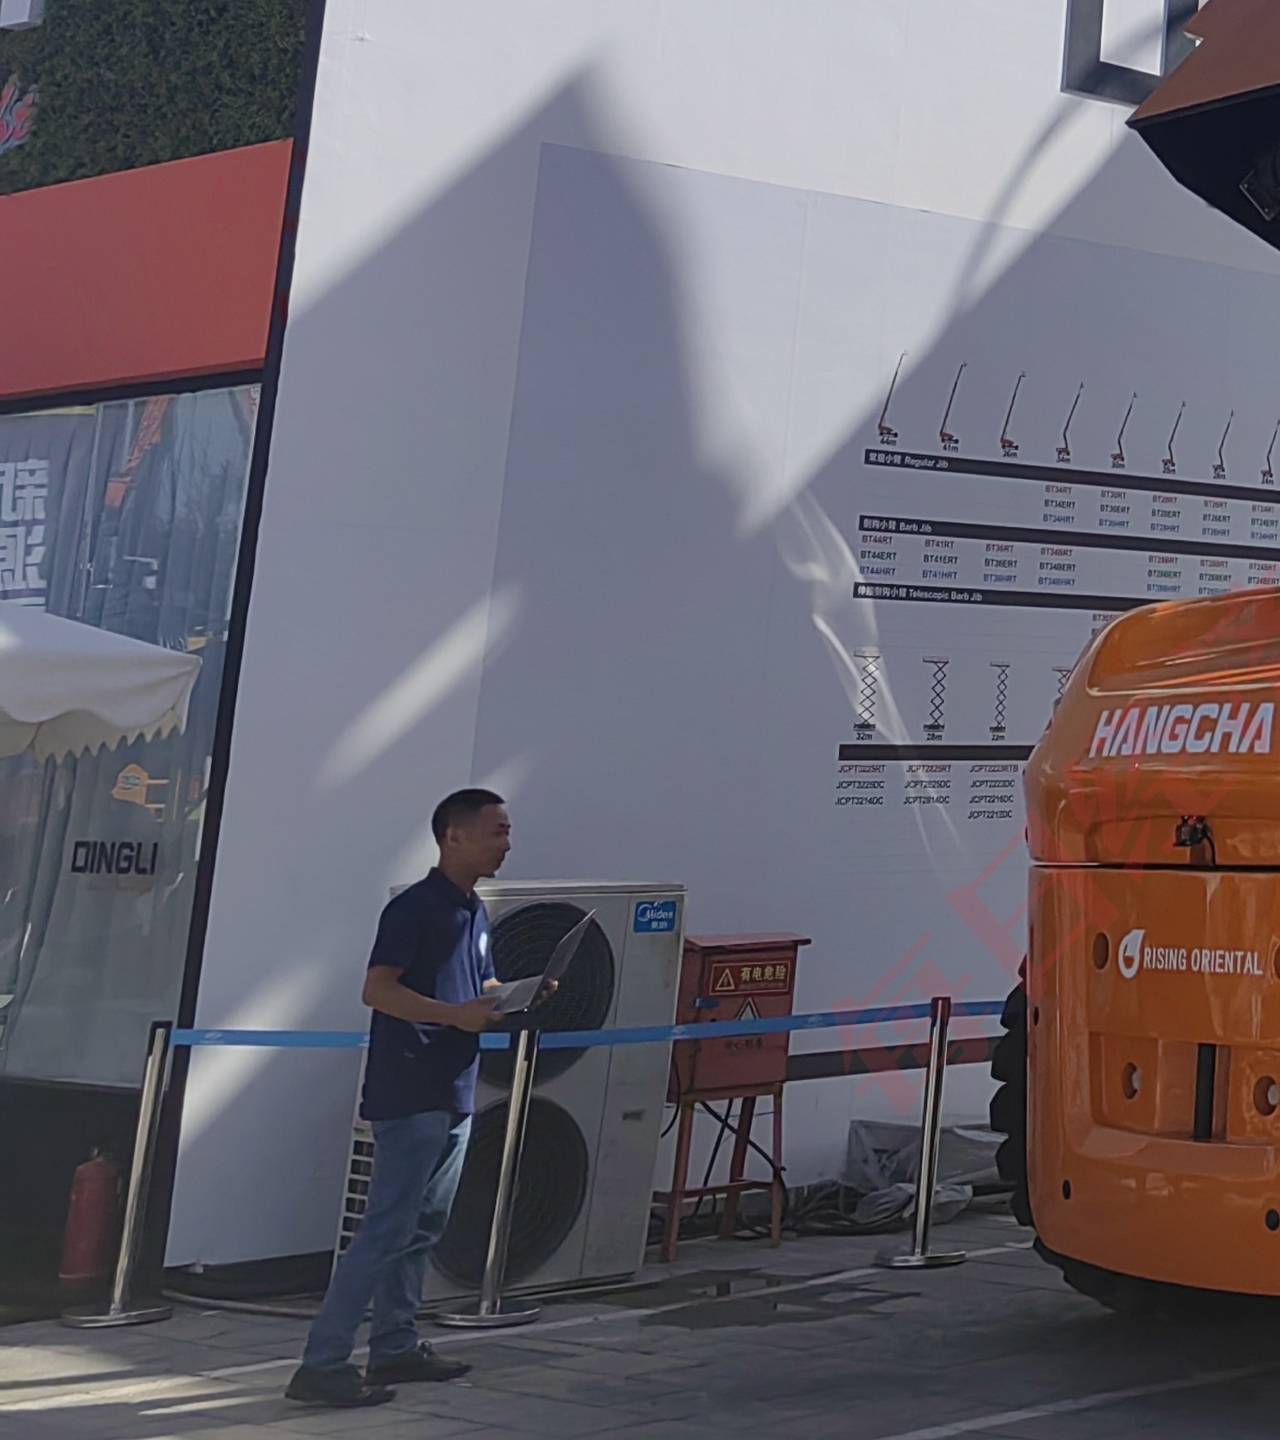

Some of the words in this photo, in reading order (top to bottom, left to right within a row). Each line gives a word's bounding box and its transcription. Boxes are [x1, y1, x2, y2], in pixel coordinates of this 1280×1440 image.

[904, 455, 936, 469] Regular
[936, 458, 949, 469] Jib
[899, 521, 919, 532] Barb
[919, 523, 932, 533] Jib
[909, 589, 950, 601] Telescopic
[950, 591, 970, 602] Barb
[970, 592, 983, 602] Jib
[856, 732, 872, 741] 32m
[926, 733, 942, 741] 28m
[1089, 702, 1274, 758] HANGCHA
[71, 839, 158, 877] DINGLI
[1143, 947, 1187, 972] RISING
[1191, 947, 1263, 975] ORIENTAL
[741, 965, 787, 981] 有电危险
